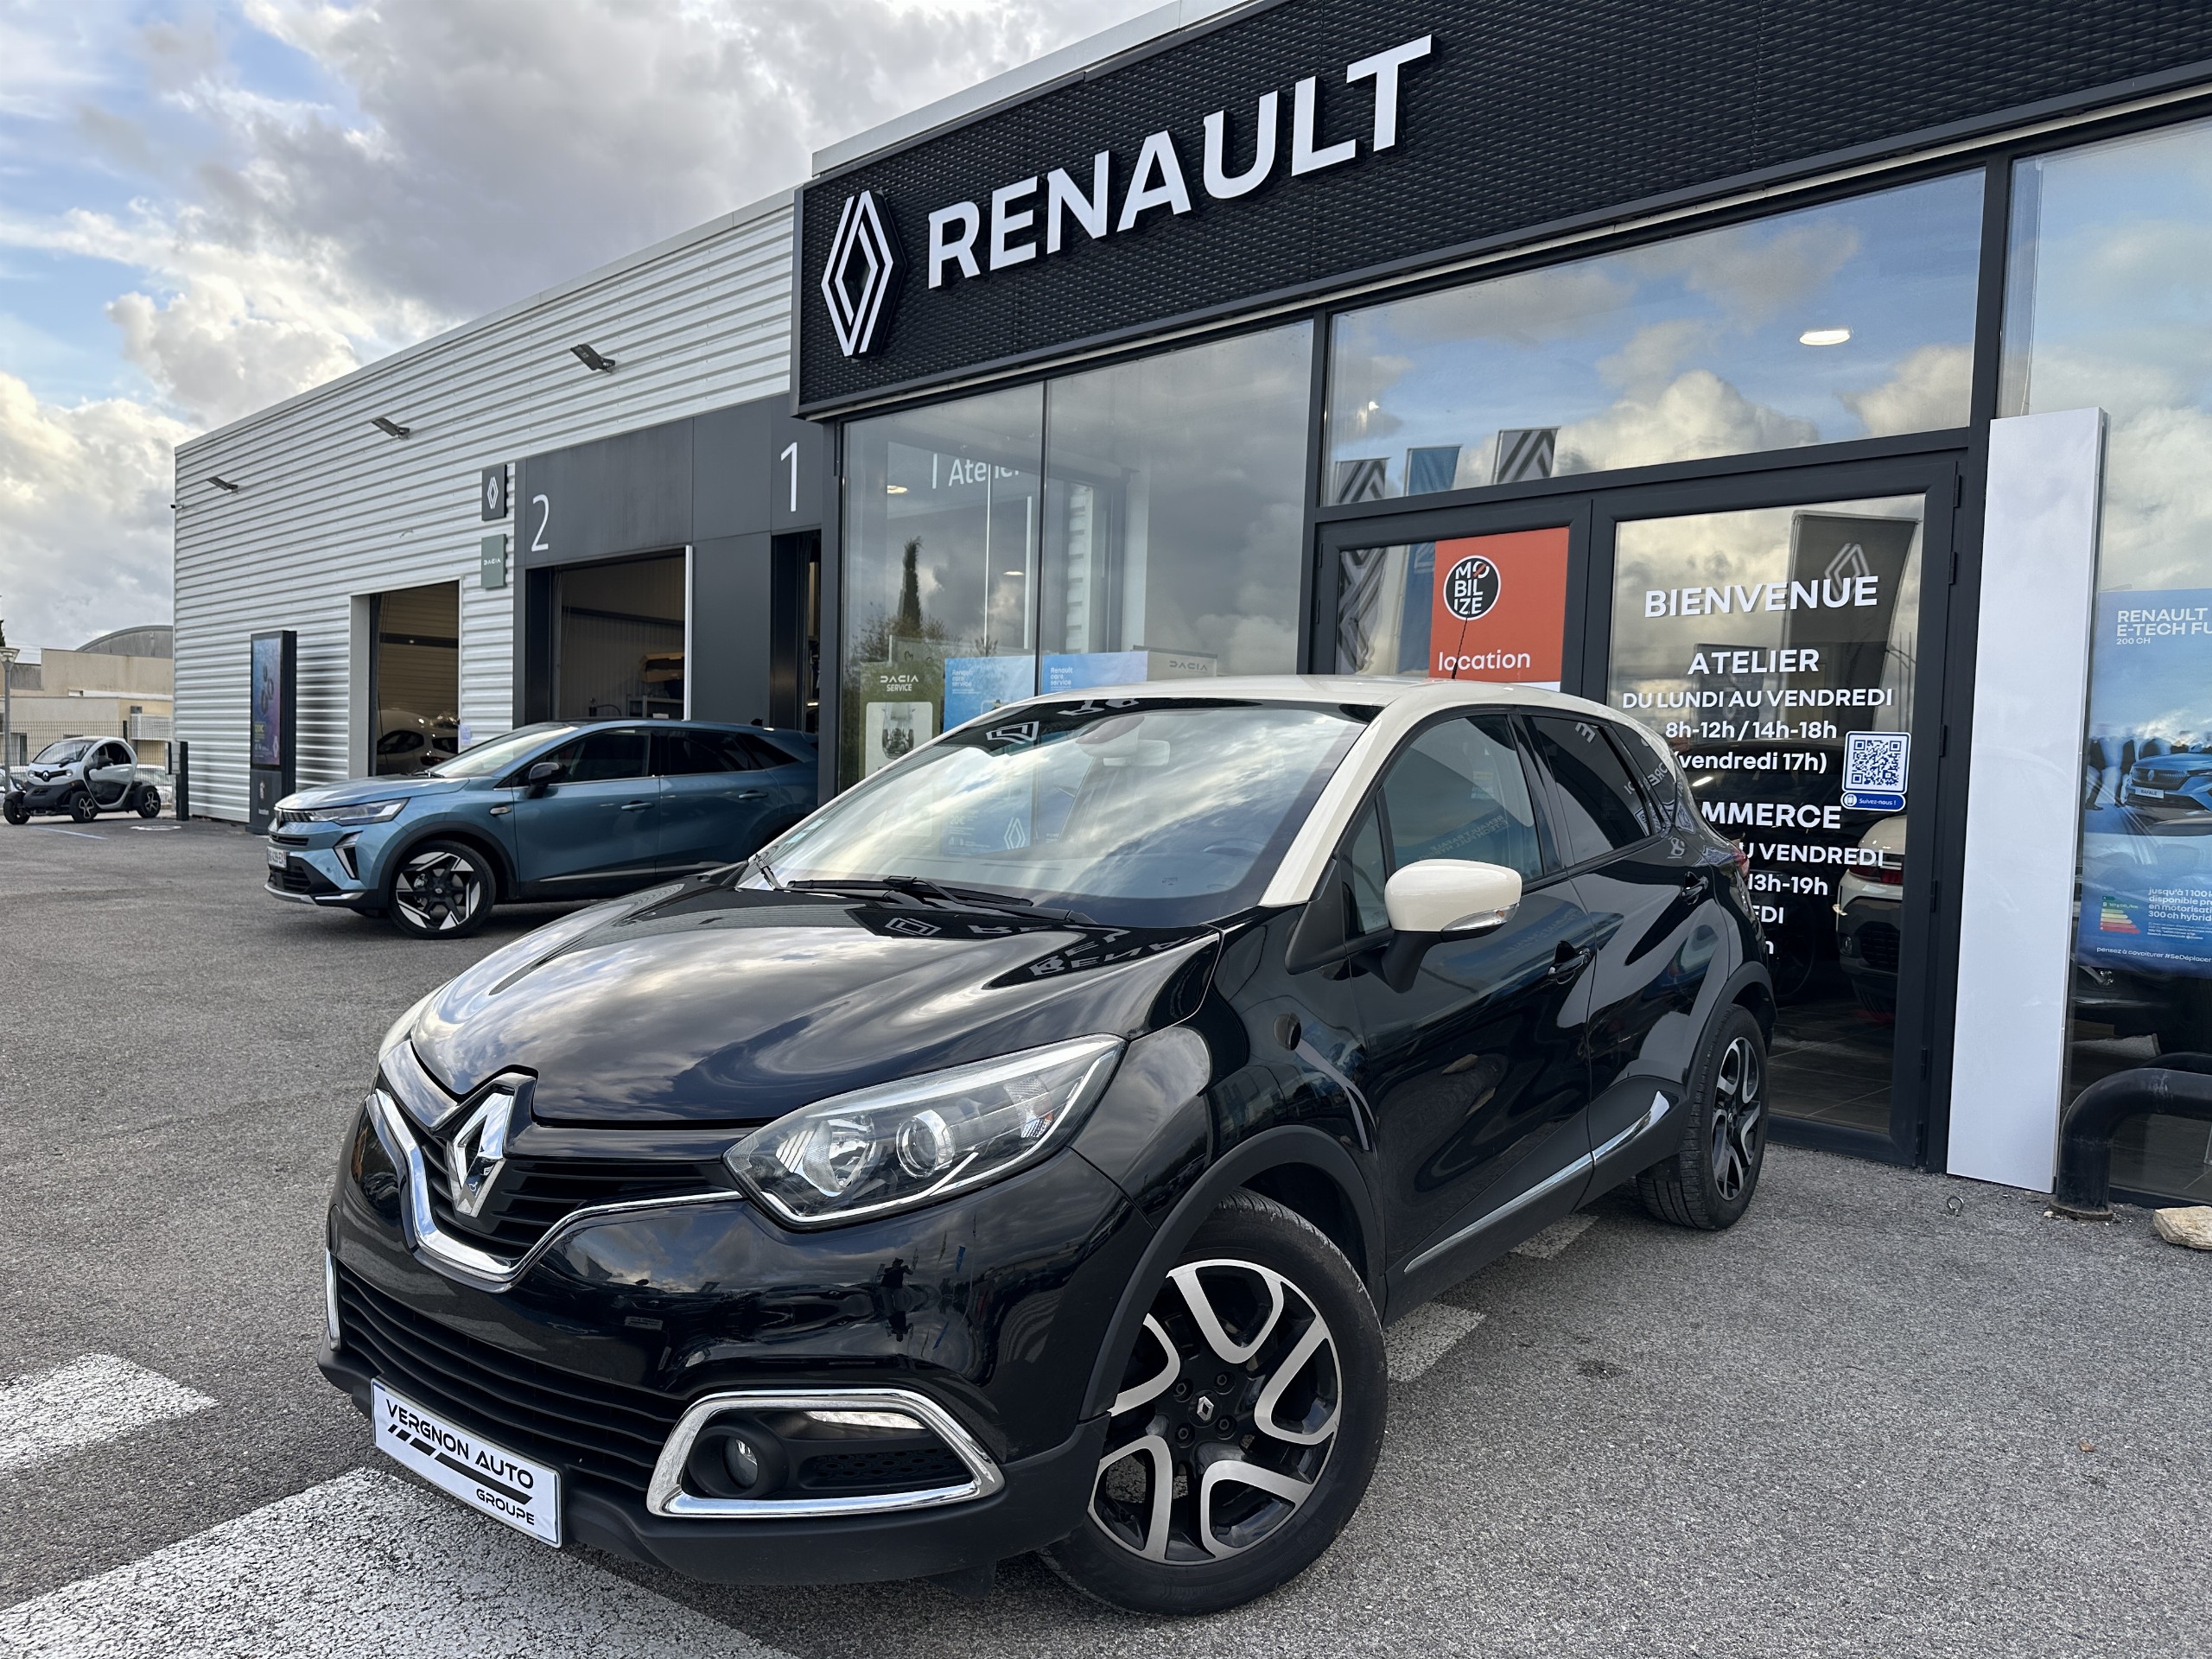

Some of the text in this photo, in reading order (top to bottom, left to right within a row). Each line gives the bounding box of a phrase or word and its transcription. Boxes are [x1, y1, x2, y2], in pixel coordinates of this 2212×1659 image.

[928, 34, 1433, 289] RENAULT
[780, 442, 798, 512] 1
[531, 493, 550, 552] 2
[483, 557, 501, 566] DACIA
[1644, 575, 1878, 618] BIENVENUE
[2117, 607, 2209, 623] RENAULT
[2116, 622, 2186, 637] E-TECH
[1169, 660, 1208, 671] DACIA
[1438, 649, 1531, 671] location
[1688, 649, 1820, 675] ATELIER
[880, 674, 919, 683] DACIA
[887, 683, 912, 692] SERVICE
[1623, 689, 1893, 709] DU LUNDI AU VENDREDI
[1665, 720, 1838, 741] 8h-12h / 14h-18h
[1783, 752, 1827, 774] 17h)
[1701, 801, 1842, 830] MMERCE
[1738, 842, 1885, 867] U VENDREDI
[2148, 887, 2183, 897] jusqu'à
[2148, 895, 2199, 905] disponible
[2148, 910, 2166, 918] 300
[2128, 950, 2164, 958] covoiturer
[385, 1398, 534, 1490] VERGNON AUTO
[476, 1488, 535, 1526] GROUPE
